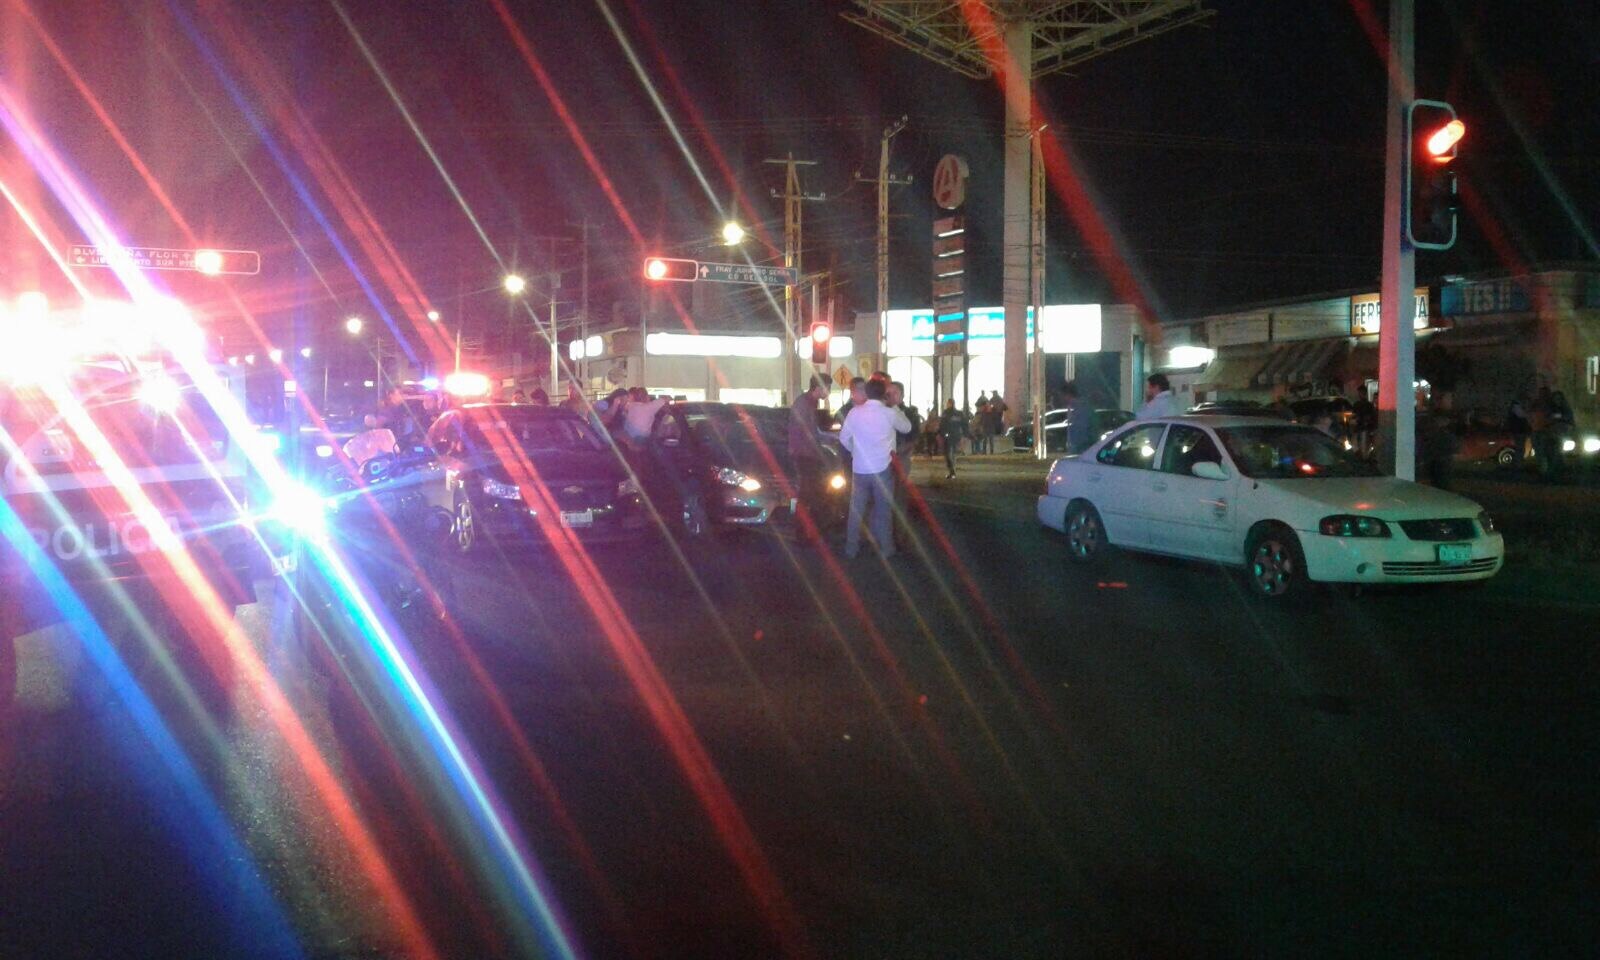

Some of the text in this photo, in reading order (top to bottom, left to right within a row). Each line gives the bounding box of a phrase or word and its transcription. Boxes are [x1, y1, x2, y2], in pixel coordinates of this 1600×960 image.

[149, 251, 178, 259] FLOR
[715, 265, 732, 273] FRAY
[27, 515, 187, 561] POLICA
